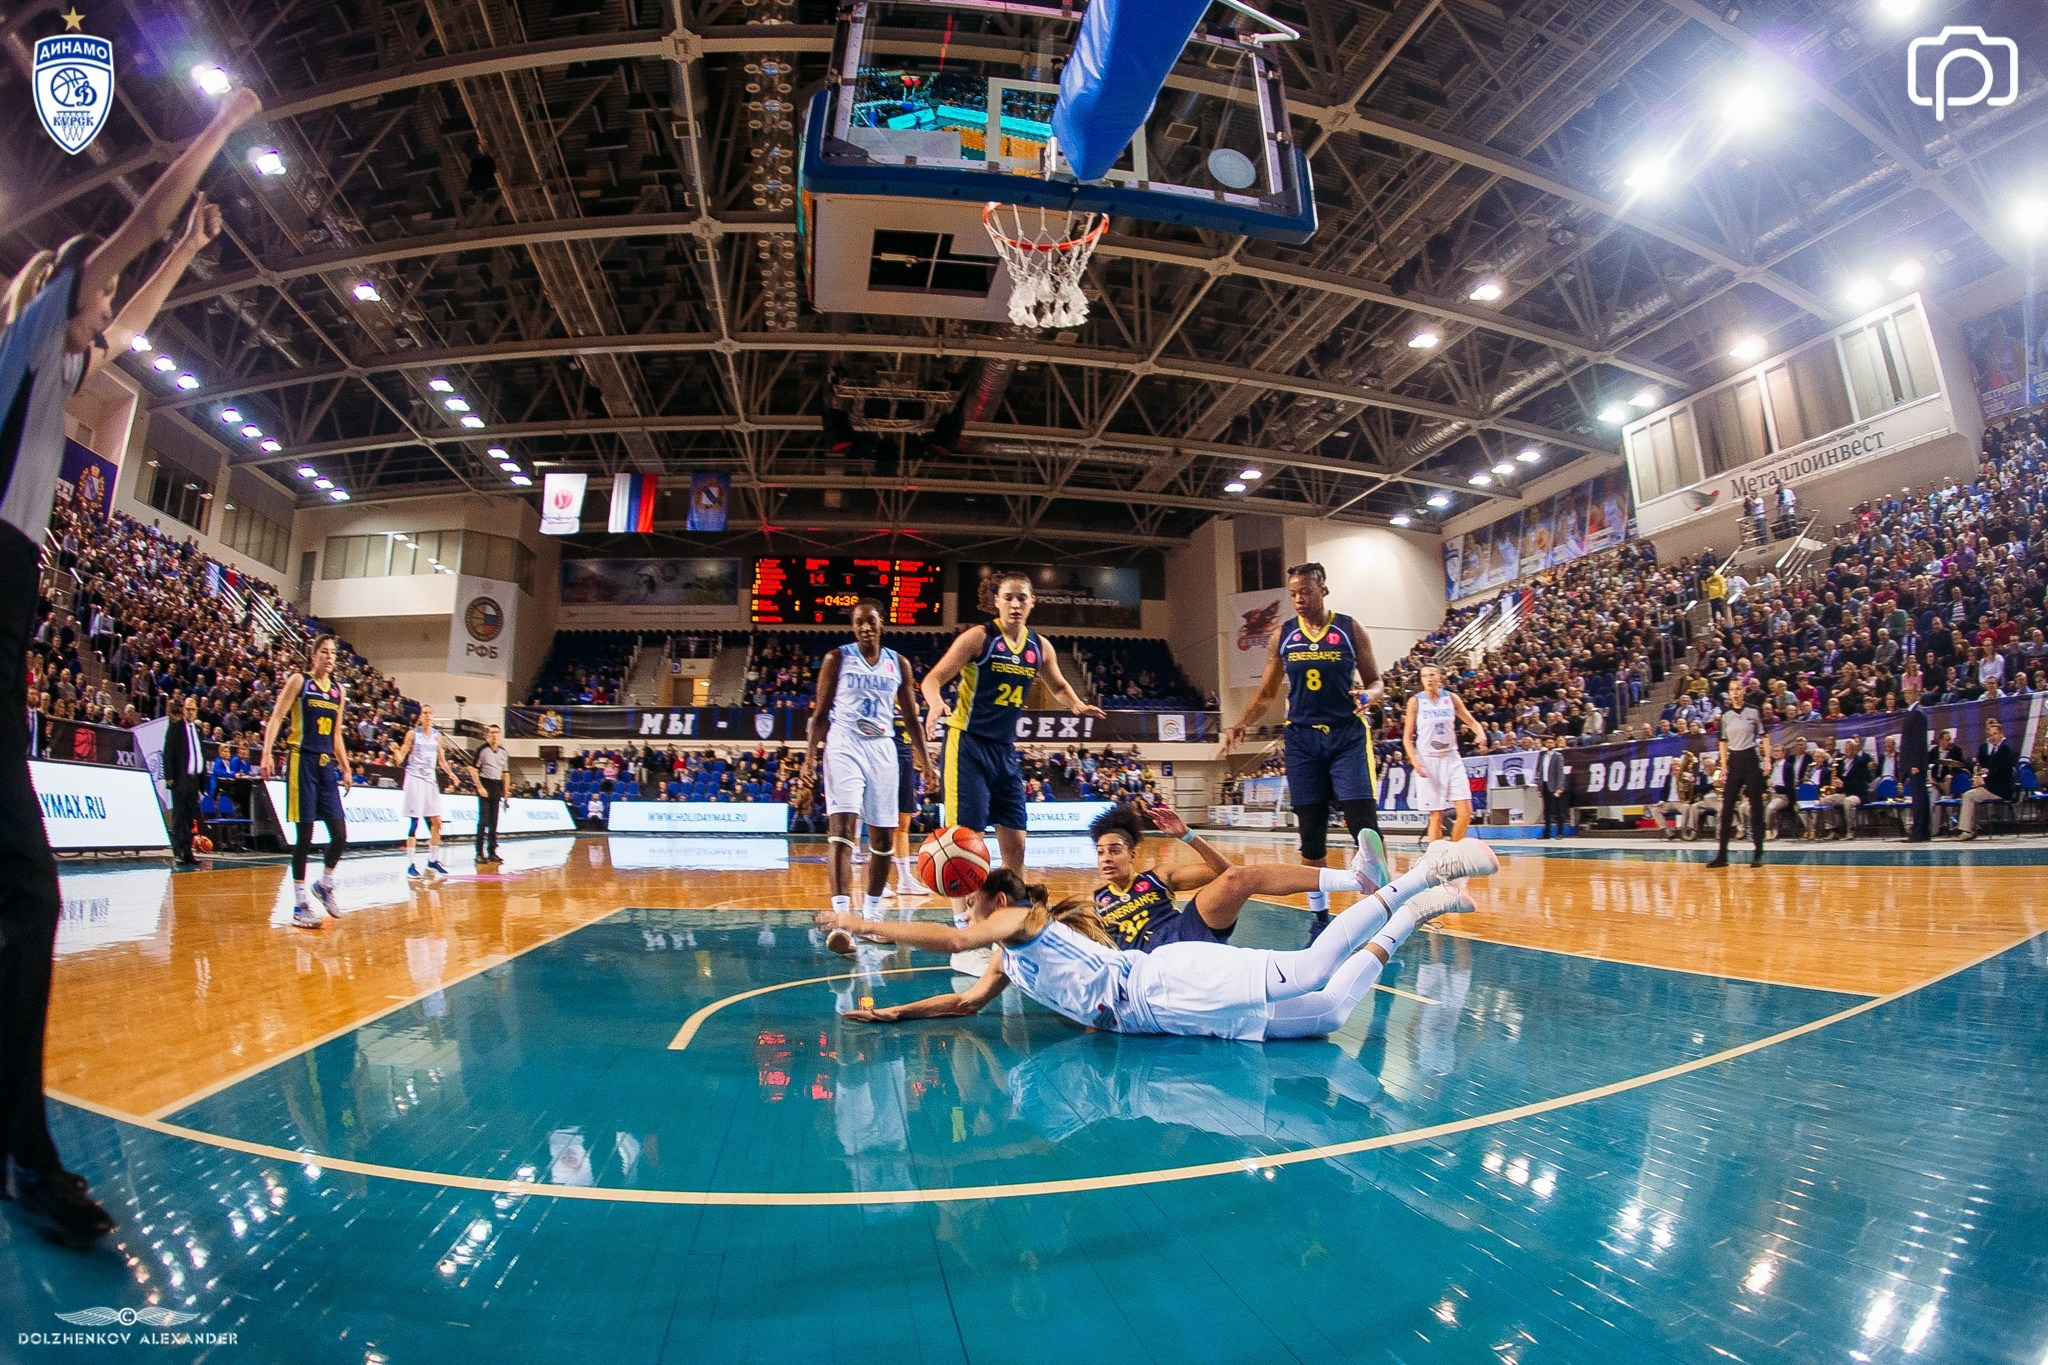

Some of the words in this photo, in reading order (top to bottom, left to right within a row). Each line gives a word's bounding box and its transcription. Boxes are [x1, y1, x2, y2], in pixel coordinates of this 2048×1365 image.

[1730, 431, 1884, 498] Металлоинвест
[809, 573, 825, 584] 14
[466, 643, 498, 659] РФБ
[1306, 668, 1322, 691] 8
[861, 698, 879, 717] 31
[994, 683, 1023, 708] 24
[317, 716, 333, 735] 10
[639, 713, 695, 735] МЫ
[1016, 716, 1094, 739] СЕХ!
[40, 793, 107, 819] YMAX.RU
[1119, 909, 1151, 943] 32
